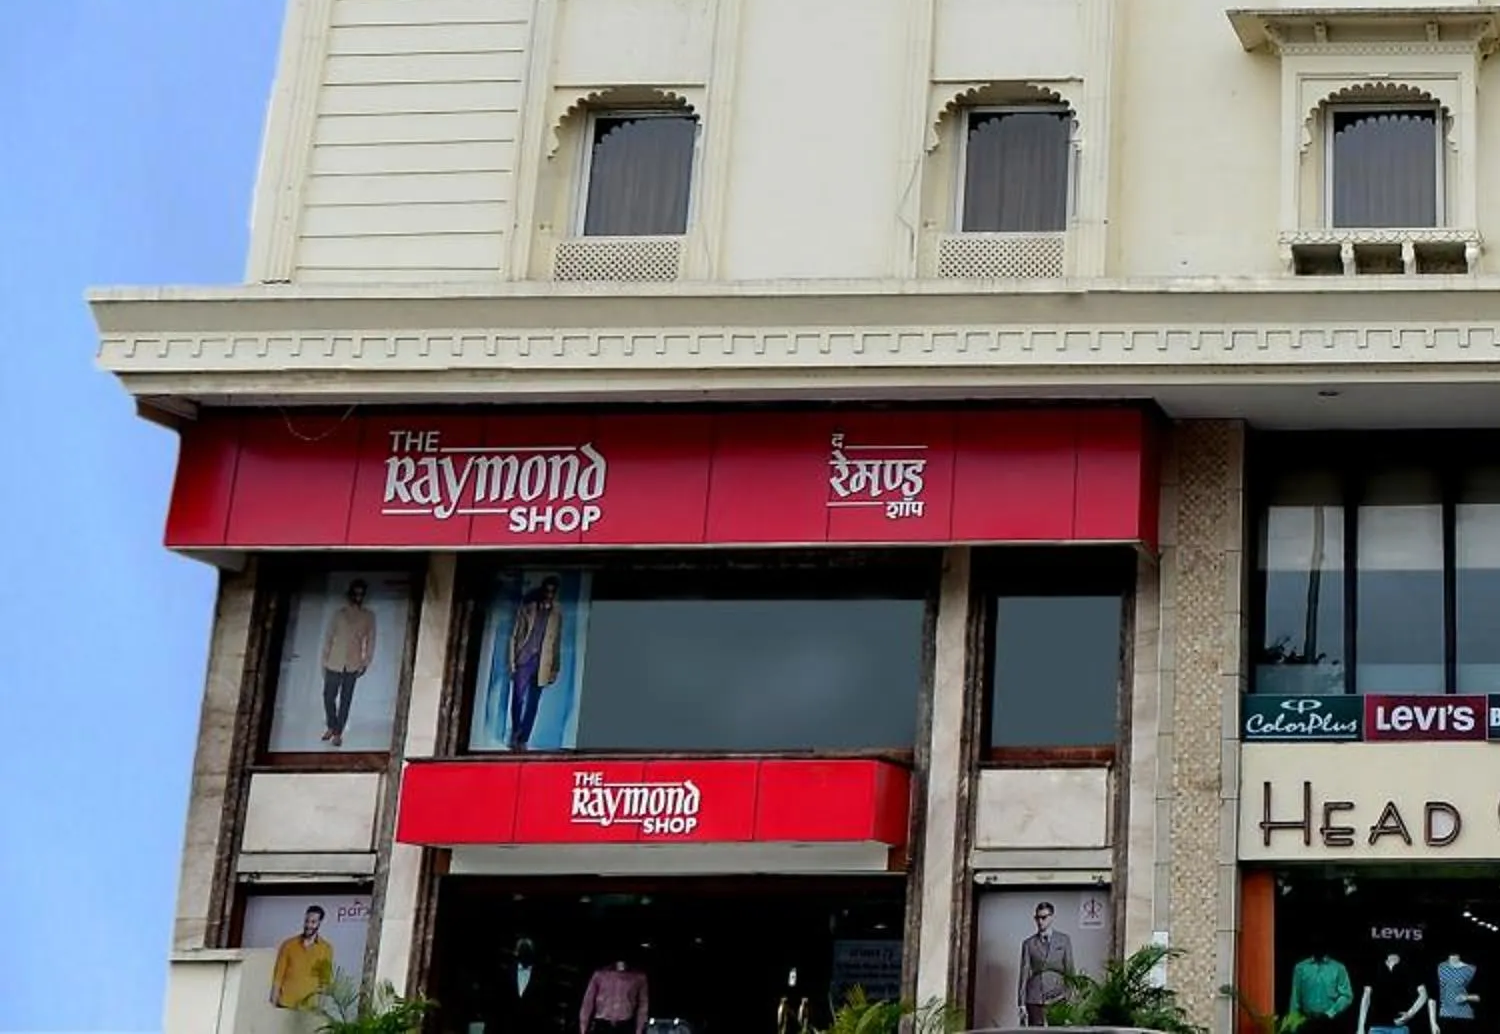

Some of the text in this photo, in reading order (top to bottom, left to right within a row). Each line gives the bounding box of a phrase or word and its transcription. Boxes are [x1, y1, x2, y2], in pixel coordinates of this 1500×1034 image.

[389, 430, 441, 453] THE
[384, 442, 607, 519] Raymond
[508, 506, 601, 533] SHOP
[1246, 713, 1357, 734] ColorPlus
[573, 772, 604, 786] THE
[571, 780, 701, 826] Raymond
[1259, 781, 1462, 847] HEAD
[643, 817, 697, 834] SHOP
